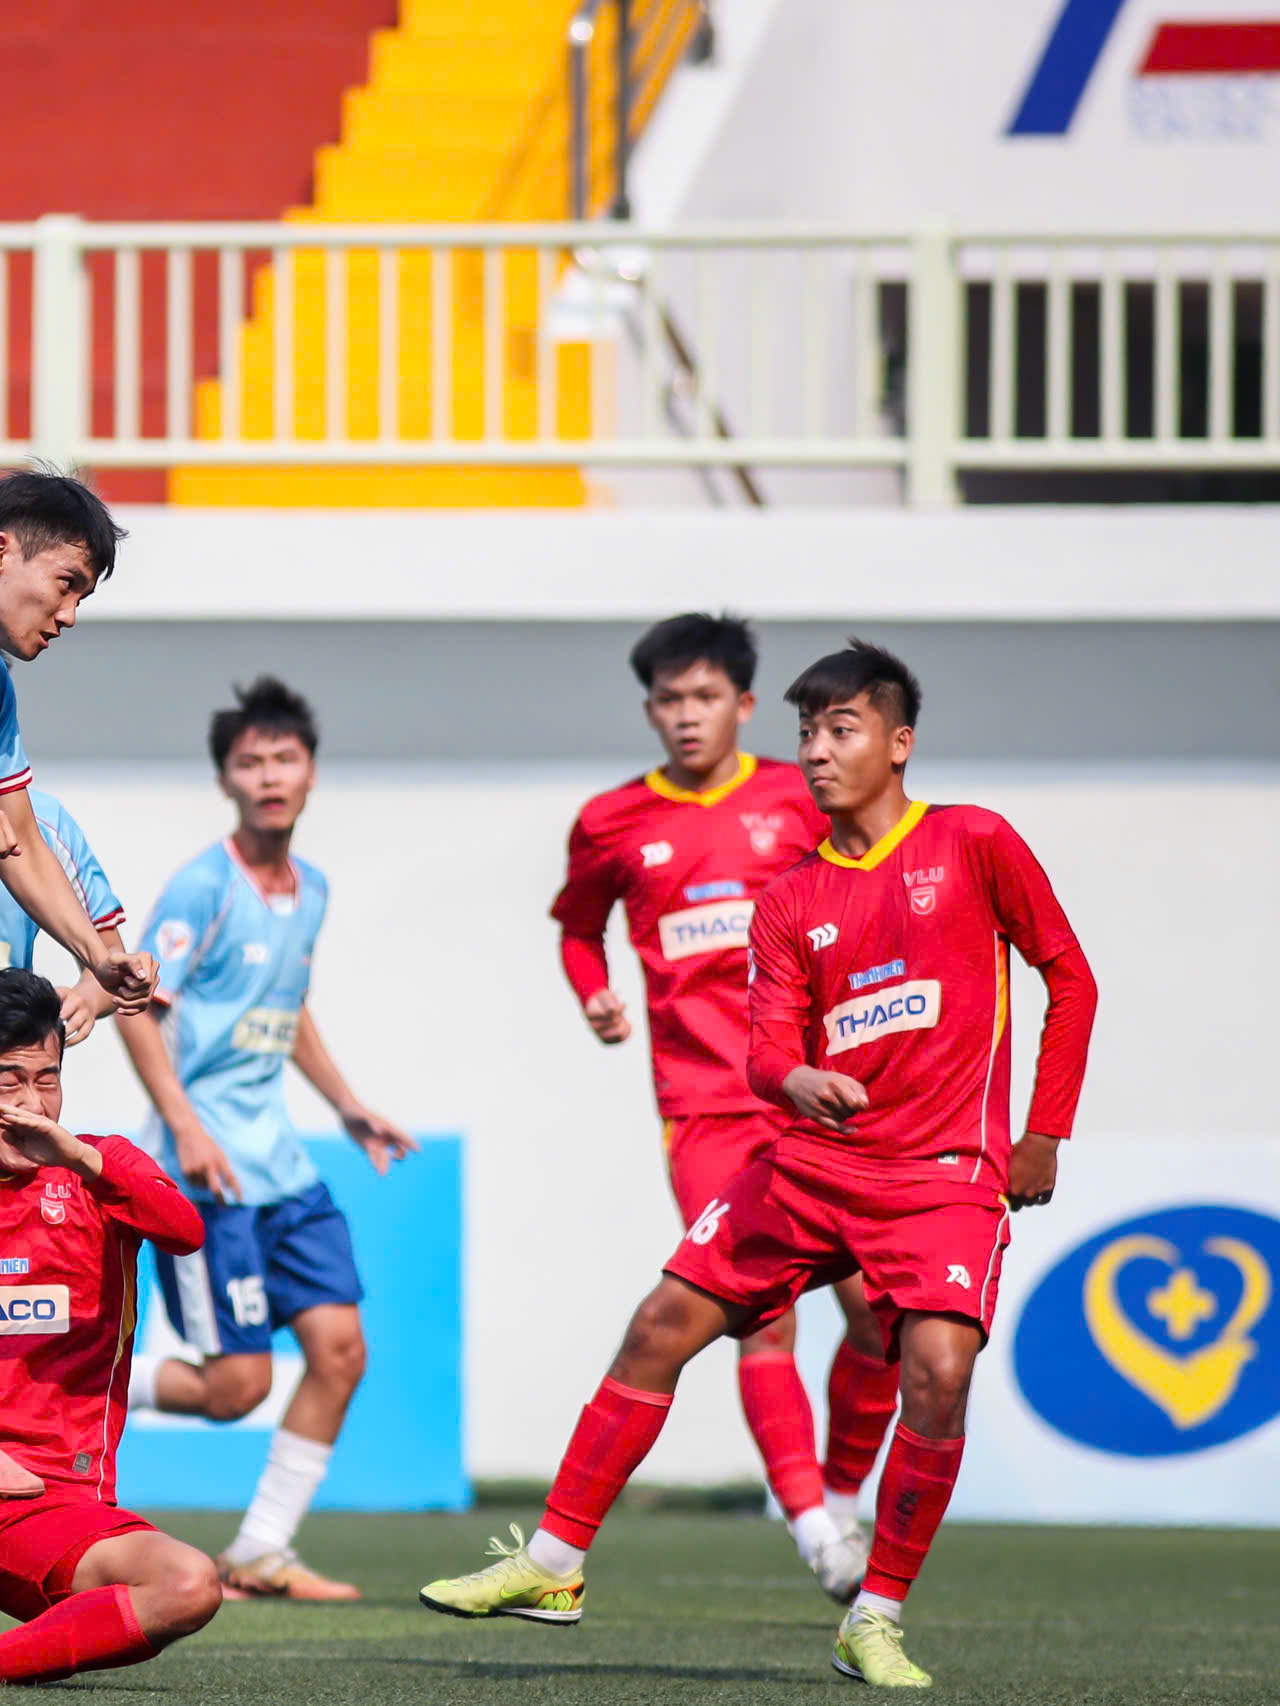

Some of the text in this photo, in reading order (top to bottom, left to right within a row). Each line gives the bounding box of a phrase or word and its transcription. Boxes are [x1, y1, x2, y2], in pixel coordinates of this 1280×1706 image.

[903, 866, 945, 887] VLU
[671, 914, 747, 944] THAC
[835, 994, 926, 1038] THACO
[45, 1183, 72, 1199] LU
[685, 1198, 730, 1245] 16
[226, 1274, 270, 1328] 15
